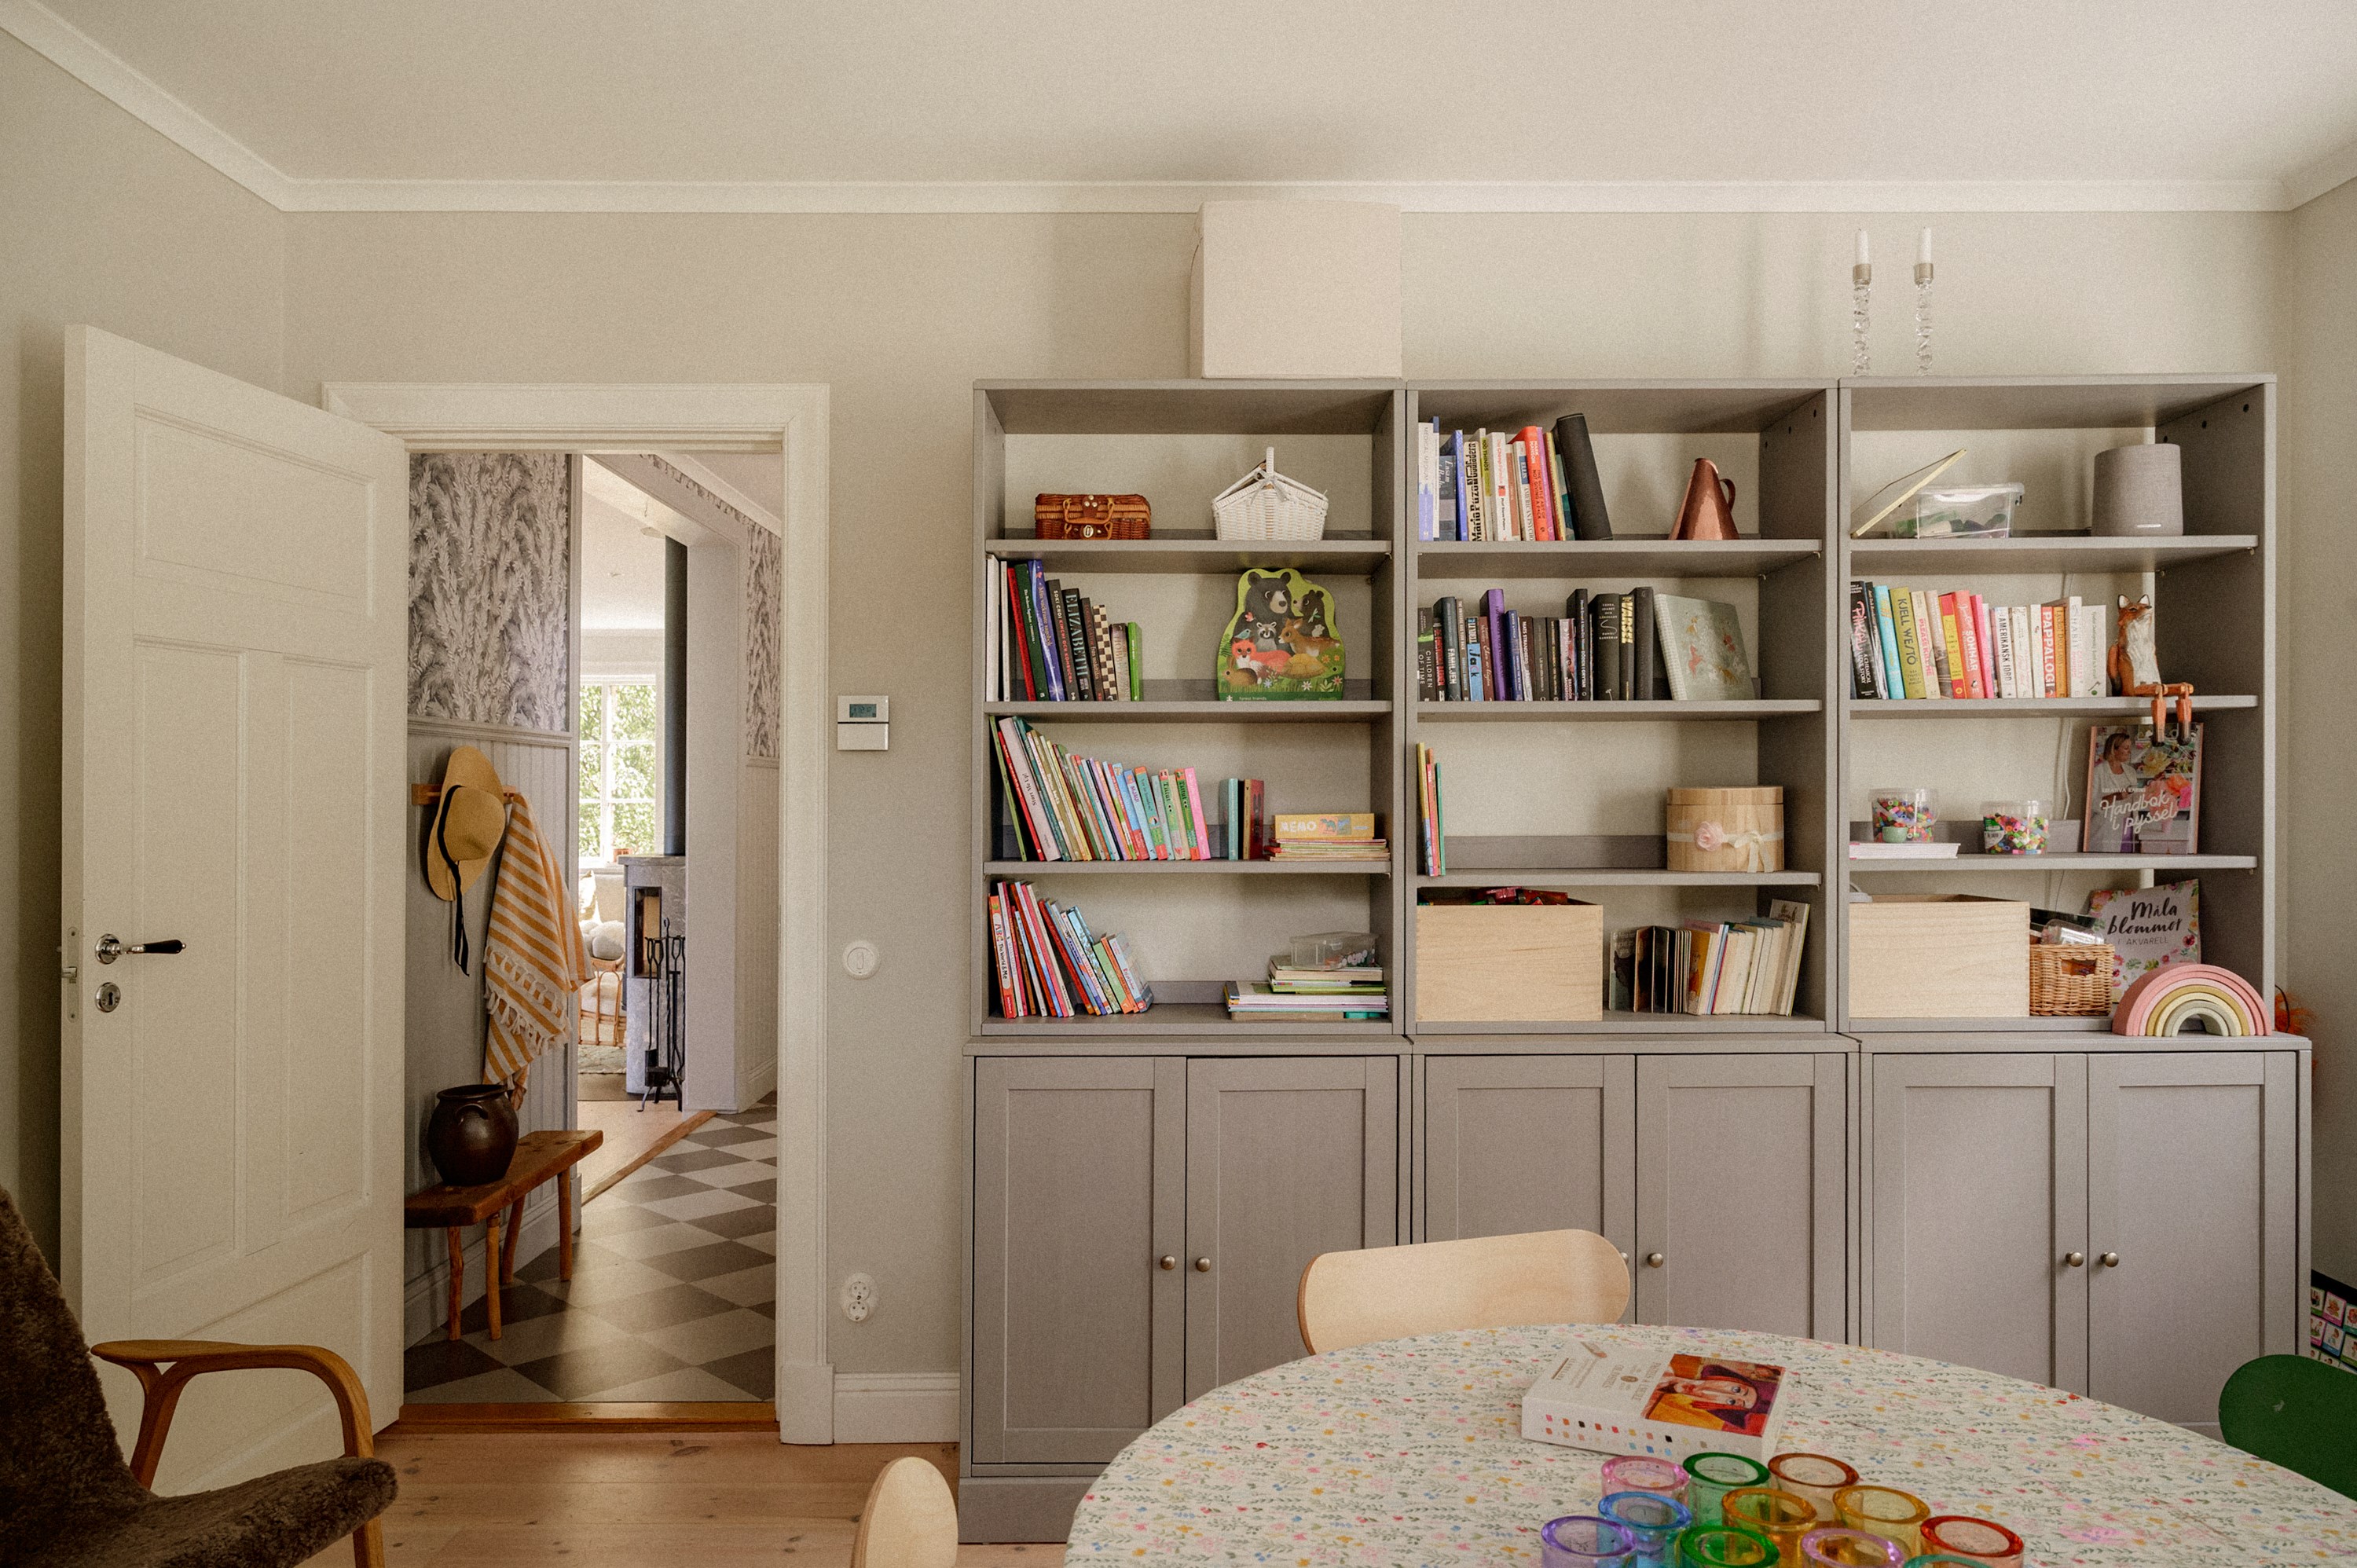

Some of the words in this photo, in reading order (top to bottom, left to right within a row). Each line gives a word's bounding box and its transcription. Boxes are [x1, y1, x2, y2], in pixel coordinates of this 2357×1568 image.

[1445, 460, 1453, 482] Ensam
[1469, 485, 1480, 512] Puzo
[1470, 512, 1483, 542] Mario
[1621, 602, 1633, 643] VARSEL
[1897, 599, 1911, 626] KJELL
[1065, 594, 1088, 676] ELIZABETH
[1918, 618, 1928, 647] PLEASE
[1999, 617, 2011, 662] AMERIKANSK
[1418, 654, 1424, 665] OF
[1903, 628, 1919, 665] WESTÖ
[1966, 630, 1978, 671] SOMMAR
[2043, 611, 2055, 687] PAPPALOGI
[1064, 653, 1072, 683] KOMBUCHA
[1447, 648, 1457, 684] FAMILJEN
[1863, 658, 1871, 683] CHEMICAL
[1026, 782, 1032, 792] Me
[1130, 786, 1140, 803] MJAU!
[1163, 782, 1171, 801] Tittut
[1178, 780, 1187, 800] Tittut
[2099, 789, 2170, 822] Handbok
[2112, 816, 2120, 830] i
[2124, 802, 2178, 835] pyssel
[1280, 820, 1318, 833] MEMO
[2131, 896, 2177, 921] Måla
[995, 924, 1004, 942] ABC
[2107, 915, 2183, 935] blommor
[2126, 936, 2169, 945] AKVARELL
[1002, 970, 1008, 980] Me
